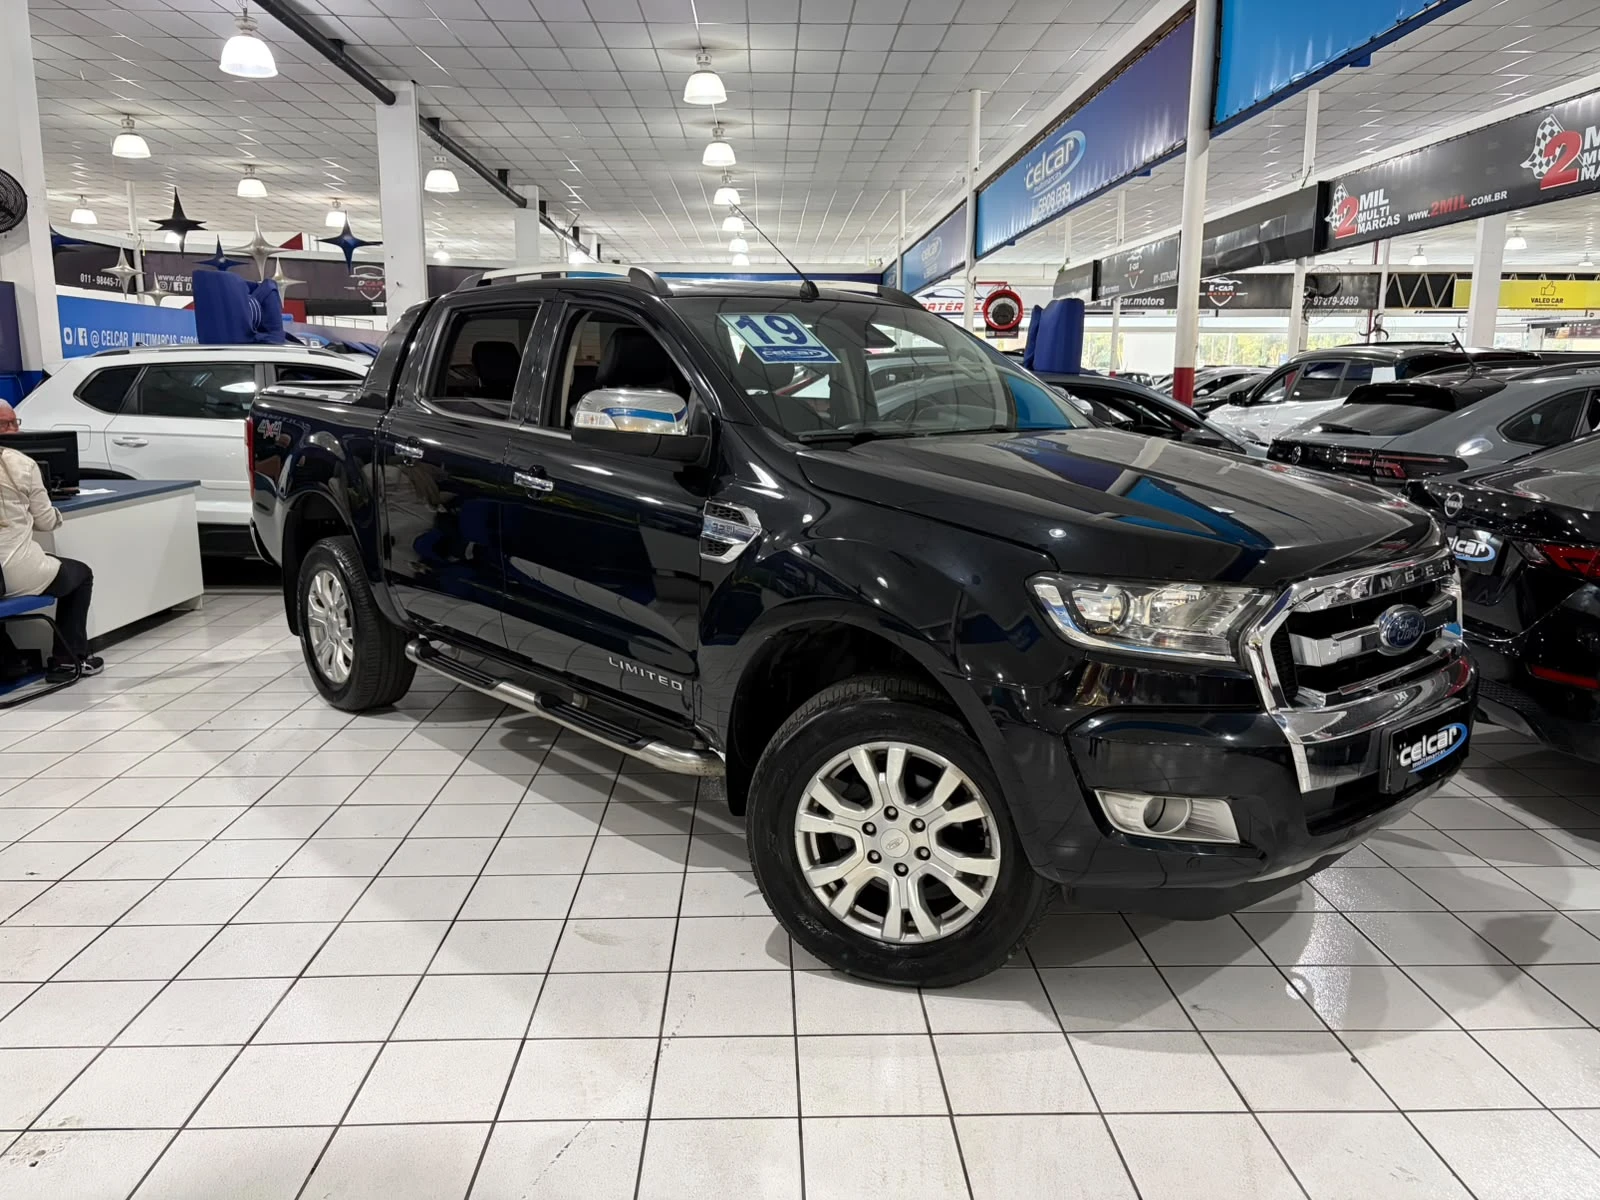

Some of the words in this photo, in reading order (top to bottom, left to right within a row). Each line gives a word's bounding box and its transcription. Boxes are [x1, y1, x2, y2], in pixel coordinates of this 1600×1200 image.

[1026, 137, 1074, 191] celcar
[1540, 130, 1582, 191] 2
[1335, 196, 1359, 239] 2
[1360, 188, 1390, 211] MIL
[1357, 205, 1390, 224] MULTI
[1357, 213, 1401, 234] MARCAS
[80, 272, 92, 284] 011
[96, 275, 121, 288] 98445-77
[1313, 296, 1359, 306] 97279-2499
[735, 315, 808, 345] 19
[762, 348, 820, 357] celcar
[1447, 535, 1486, 556] lcar
[608, 656, 683, 691] LIMITED
[1400, 725, 1457, 767] celcar
